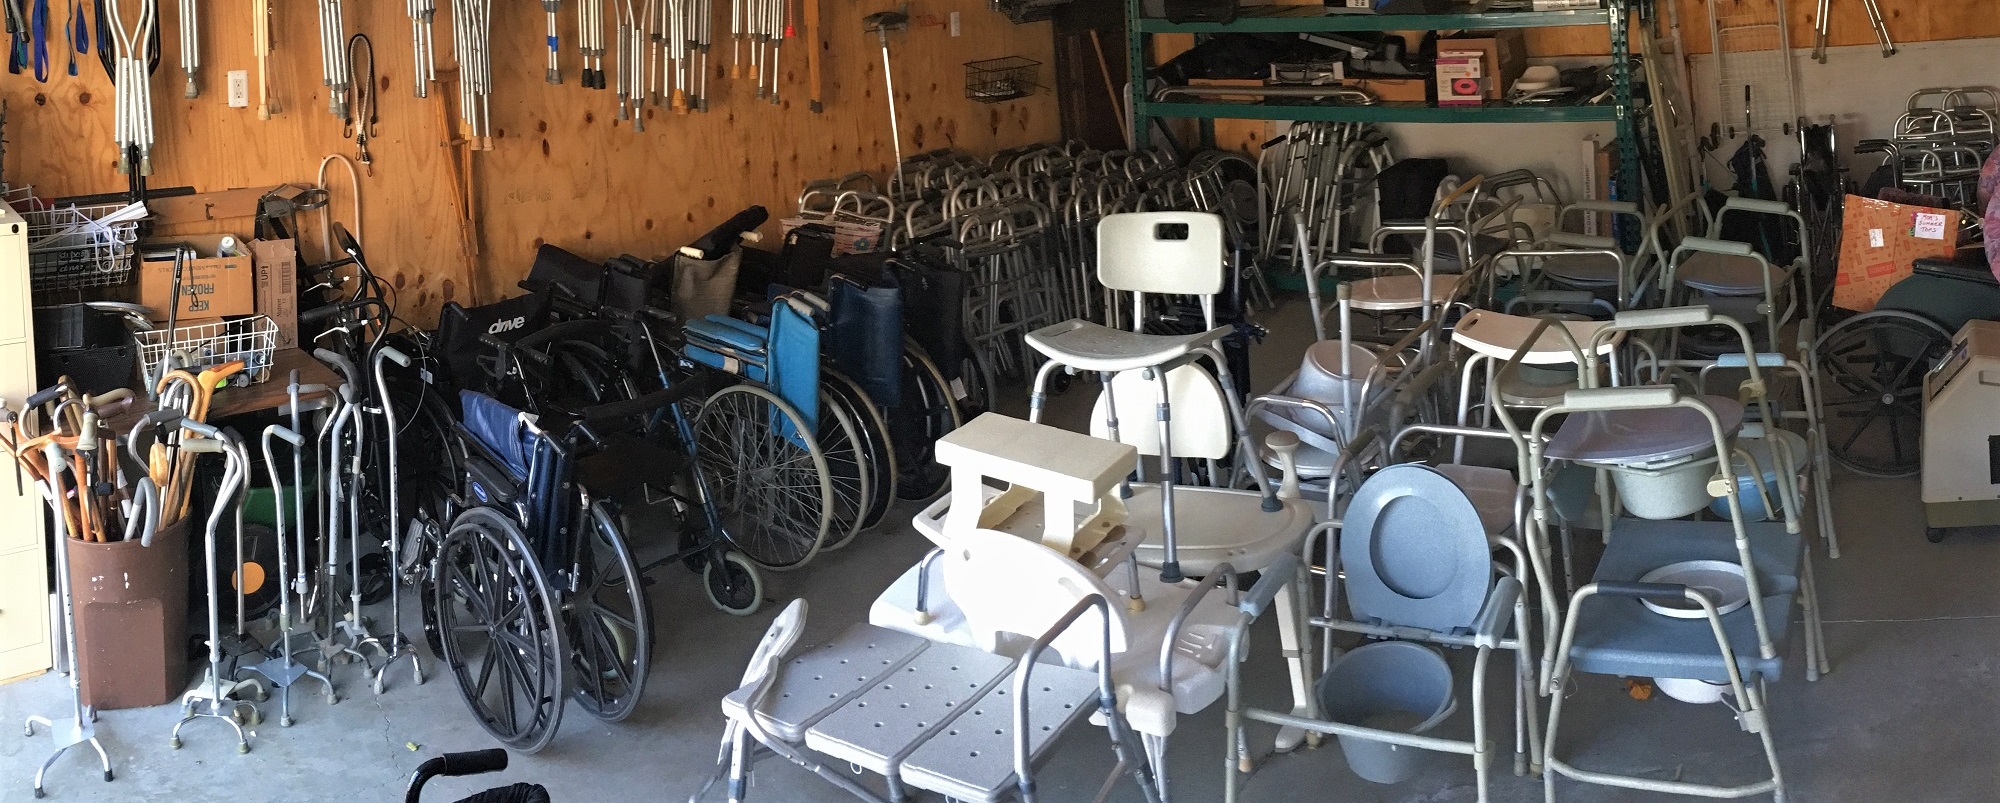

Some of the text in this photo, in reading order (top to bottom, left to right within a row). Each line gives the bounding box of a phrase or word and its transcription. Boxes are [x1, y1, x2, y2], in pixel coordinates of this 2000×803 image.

[260, 269, 269, 281] UP
[181, 282, 215, 296] FROZEN
[188, 300, 210, 312] KEEP
[488, 315, 525, 335] drive
